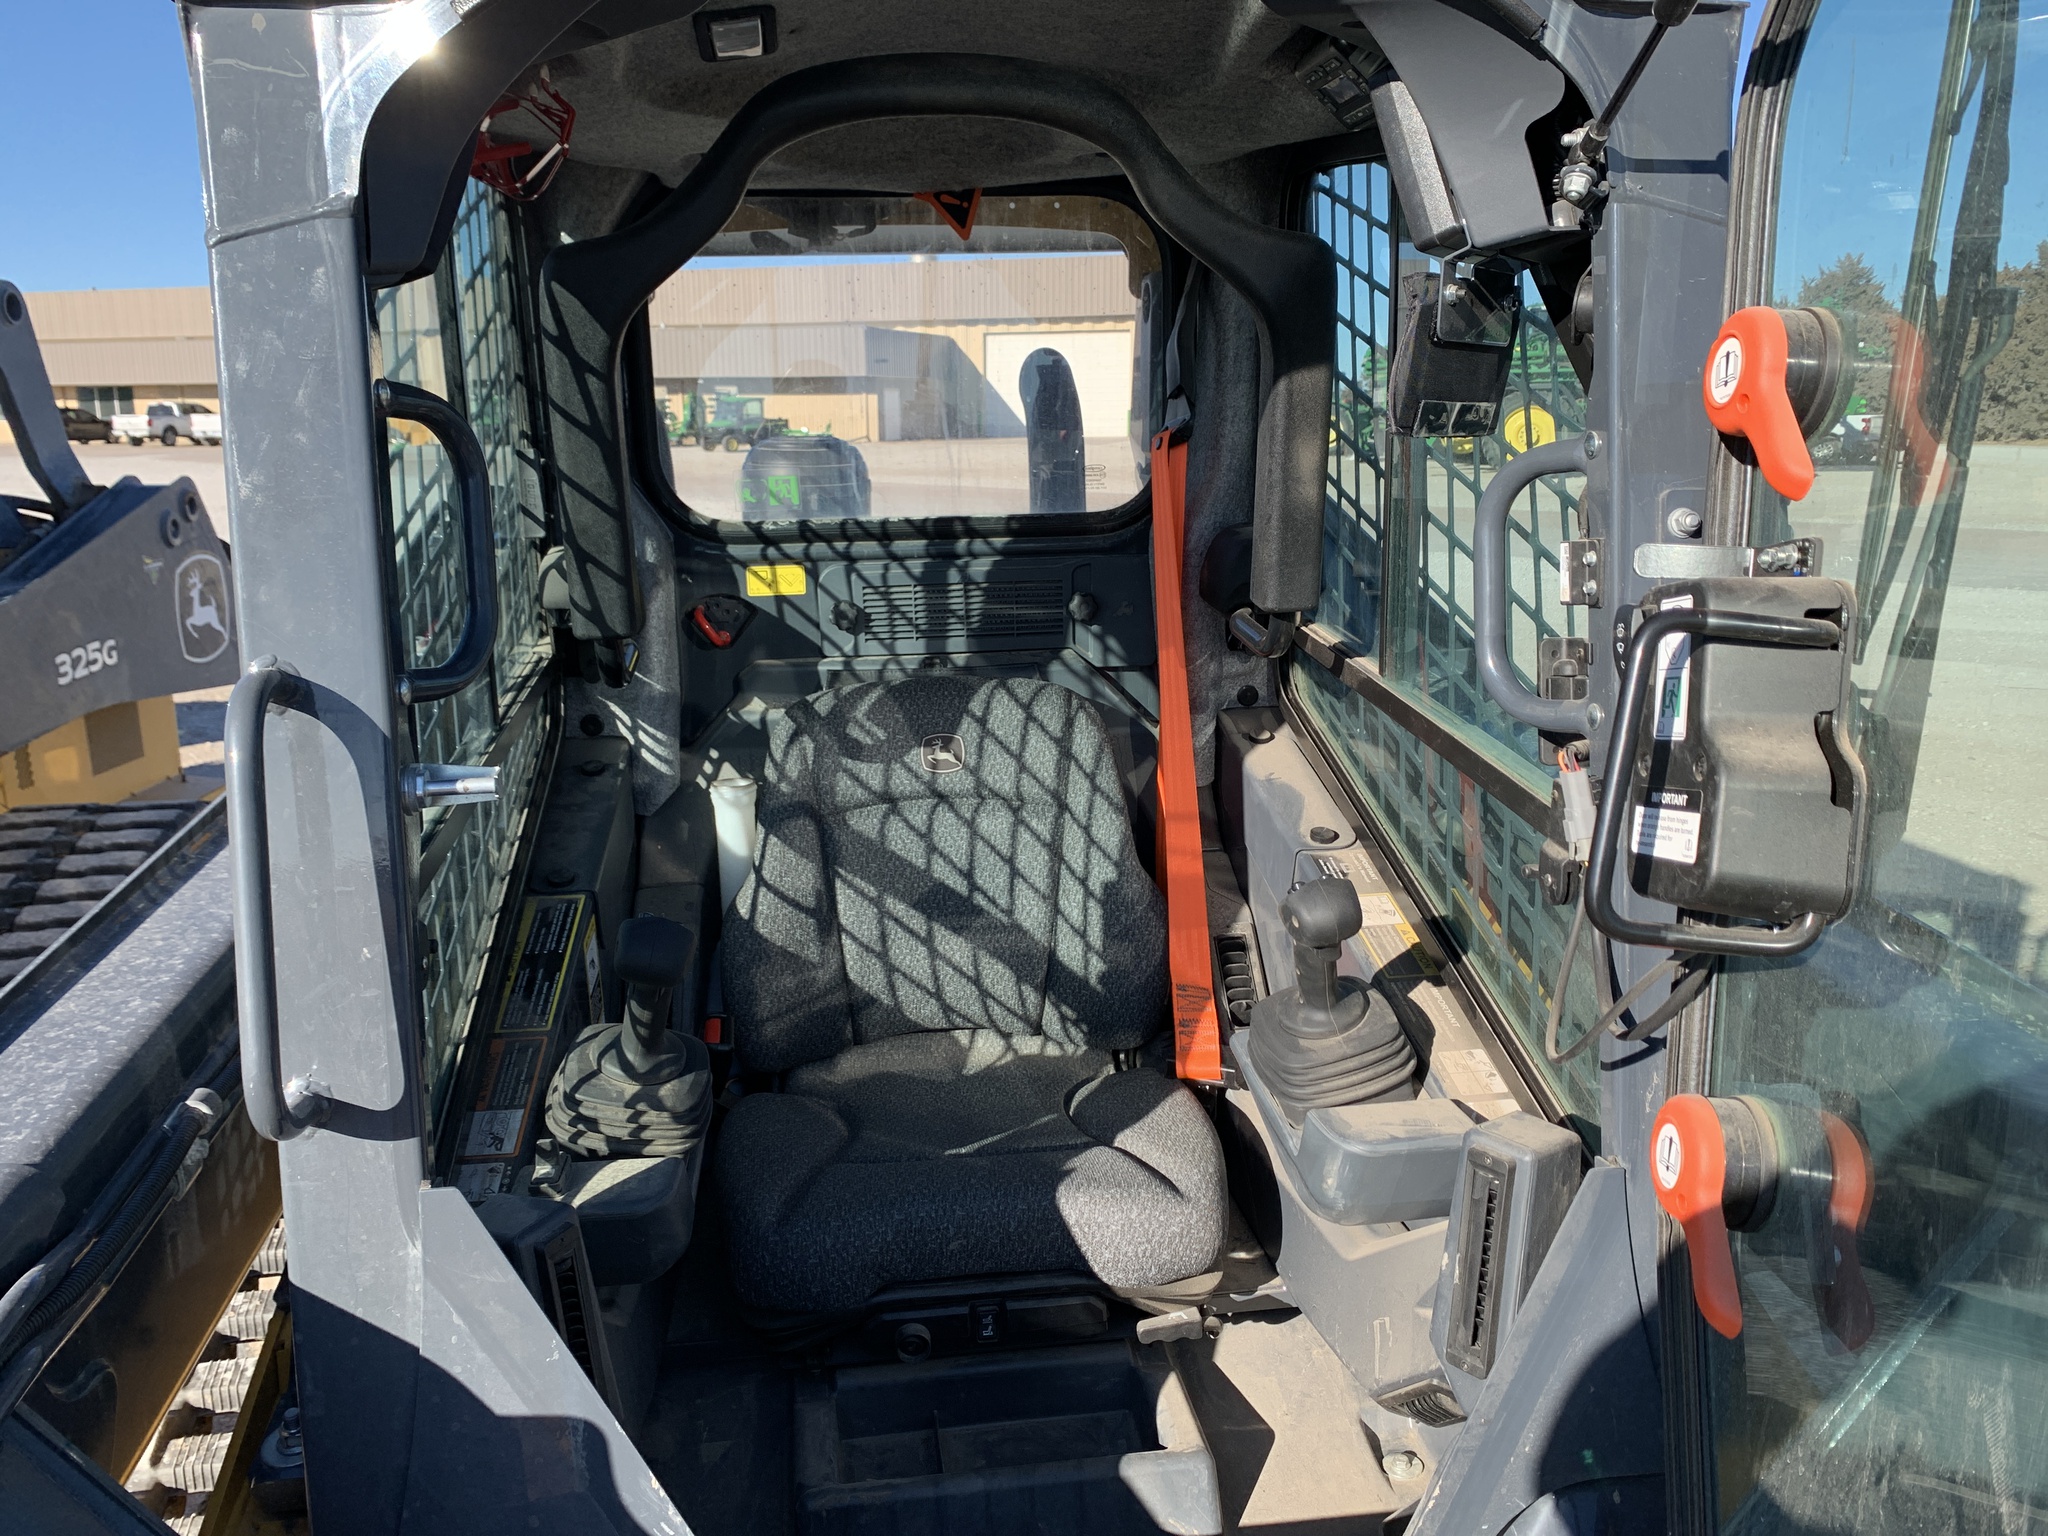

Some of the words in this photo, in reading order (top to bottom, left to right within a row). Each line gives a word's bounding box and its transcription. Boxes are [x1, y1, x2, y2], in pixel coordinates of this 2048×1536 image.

[54, 638, 119, 686] 325G
[1651, 792, 1688, 806] IMPORTANT
[1357, 853, 1378, 880] IMPORTANT
[1406, 936, 1433, 969] CAUTION
[1430, 987, 1460, 1028] IMPORTANT
